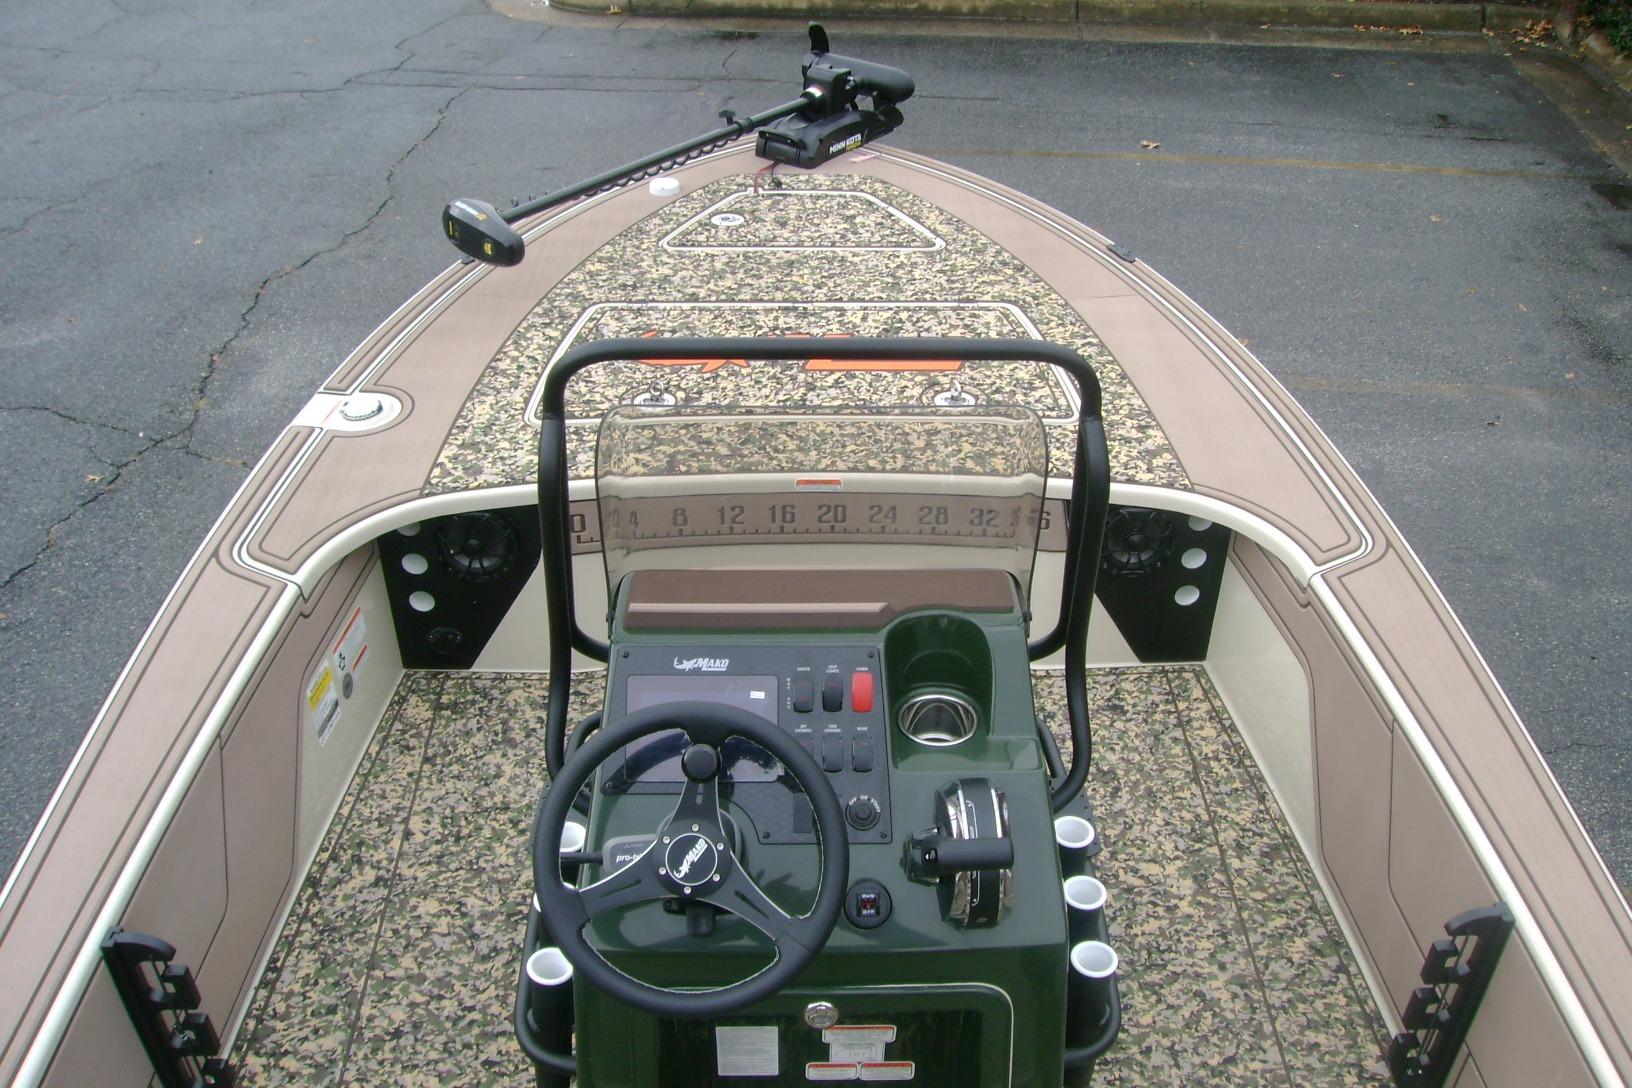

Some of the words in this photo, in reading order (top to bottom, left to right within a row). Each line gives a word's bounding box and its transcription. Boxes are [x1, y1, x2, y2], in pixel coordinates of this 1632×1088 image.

[829, 140, 846, 155] MINN
[846, 133, 862, 147] KOTA
[672, 507, 688, 526] 8
[717, 505, 745, 525] 12
[769, 504, 796, 524] 16
[818, 504, 847, 524] 20
[869, 505, 897, 524] 24
[919, 506, 949, 525] 28
[969, 508, 999, 527] 32
[695, 657, 730, 671] MAKO
[870, 798, 881, 813] START
